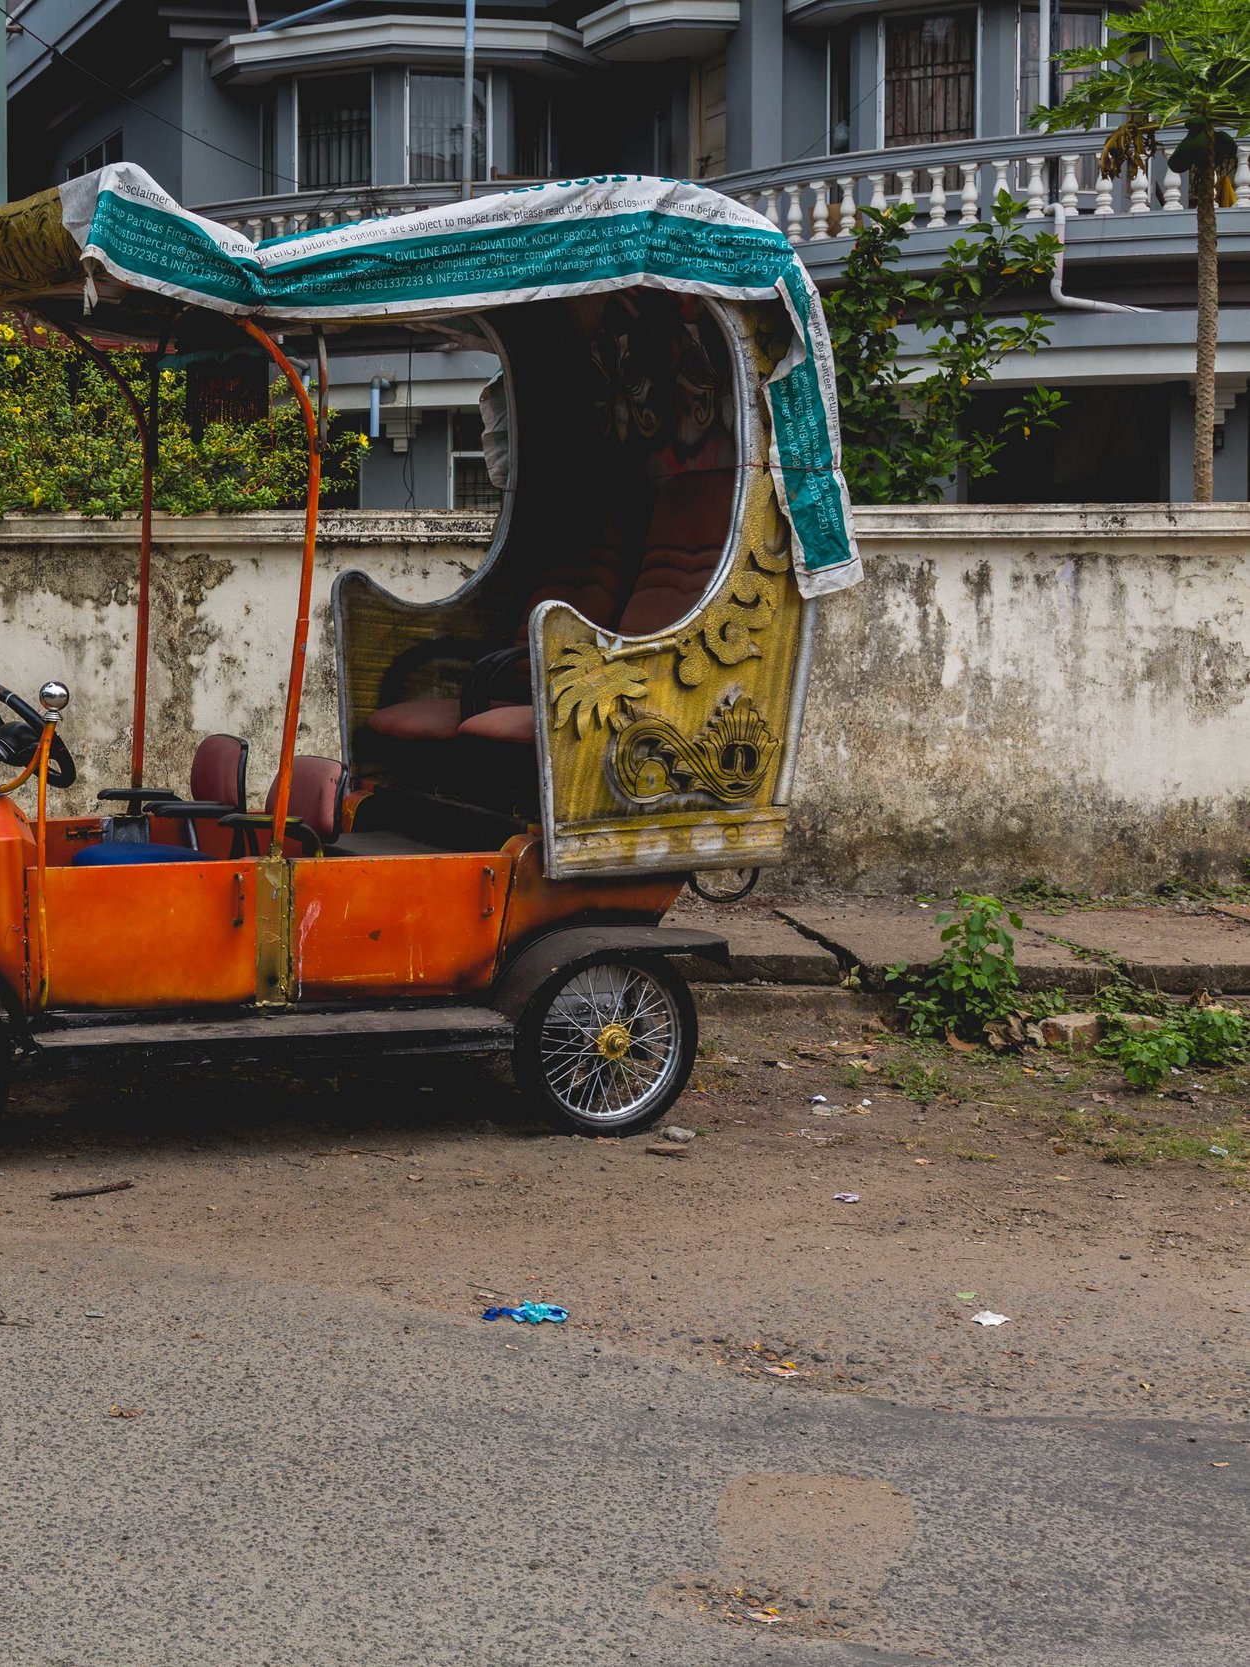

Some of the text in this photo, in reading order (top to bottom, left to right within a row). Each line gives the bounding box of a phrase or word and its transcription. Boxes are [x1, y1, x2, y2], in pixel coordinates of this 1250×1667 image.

[126, 213, 164, 234] Paribas
[165, 225, 211, 250] Financial
[395, 250, 417, 262] CIVIL
[419, 246, 440, 259] LINE
[302, 237, 338, 254] futures
[340, 235, 348, 246] &
[350, 228, 388, 242] options
[390, 225, 405, 235] are
[408, 219, 442, 233] subject
[444, 218, 454, 228] to
[457, 213, 490, 226] market
[514, 208, 543, 223] please
[545, 205, 565, 216] read
[567, 203, 582, 214] the
[585, 200, 602, 211] risk
[604, 197, 653, 210] disclosure
[697, 204, 726, 219] before
[433, 255, 487, 271] Compliance
[668, 238, 701, 255] Identity
[160, 255, 168, 267] &
[354, 275, 424, 290] INB261337233
[426, 274, 434, 285] &
[435, 267, 504, 284] INF261337233
[512, 262, 552, 277] Portfolio
[812, 321, 823, 338] not
[814, 340, 831, 390] guarantee
[781, 396, 792, 420] Regn
[819, 475, 830, 490] For
